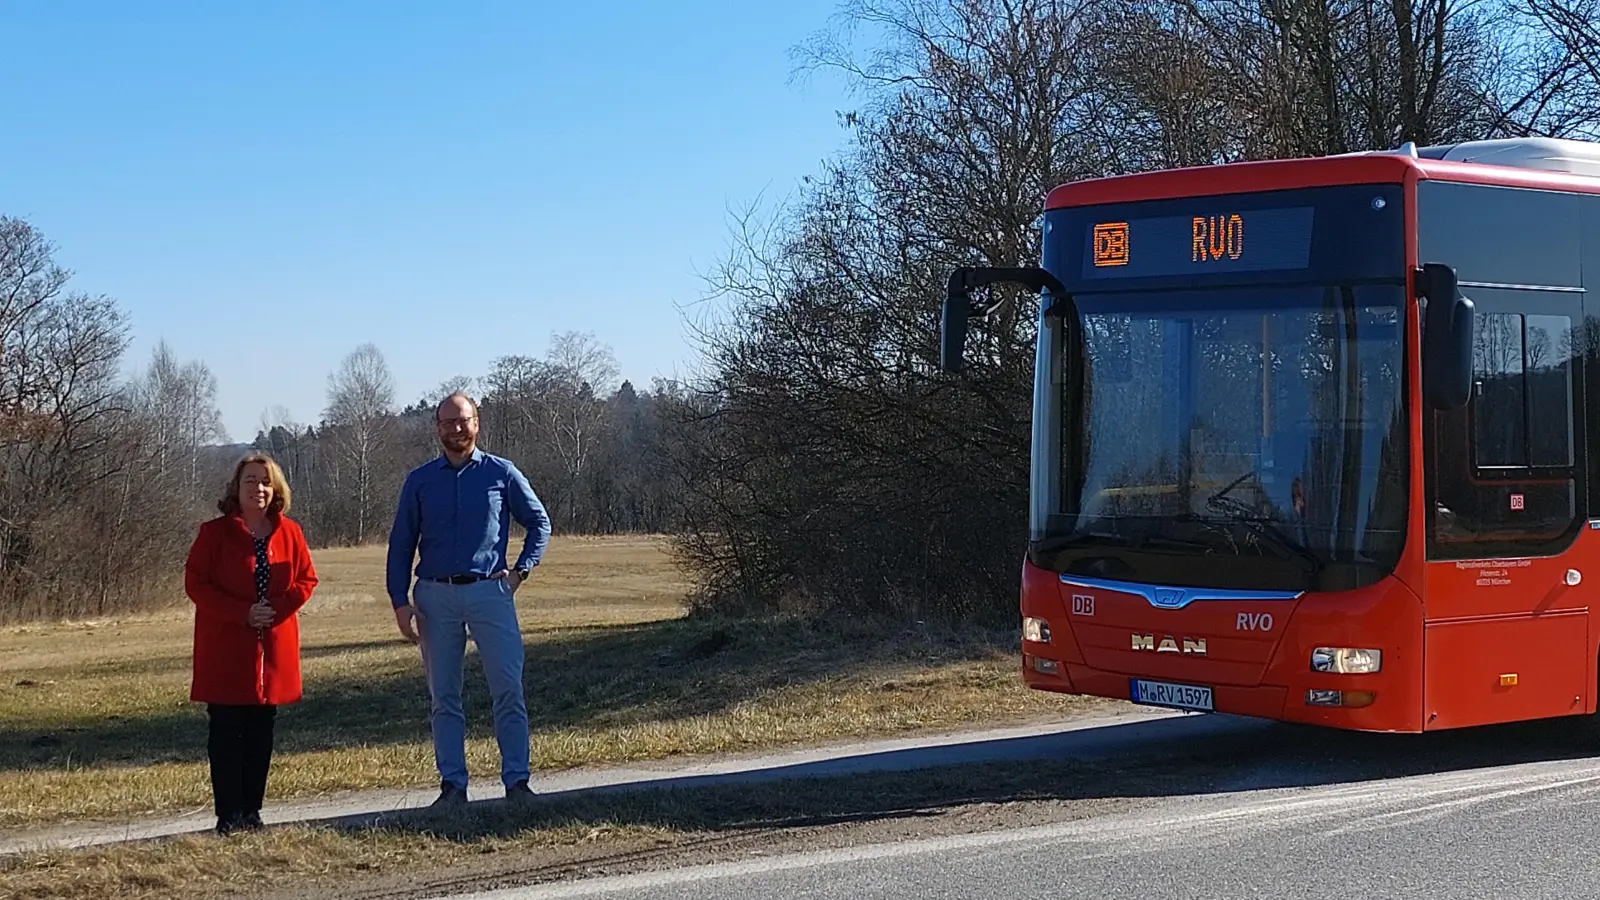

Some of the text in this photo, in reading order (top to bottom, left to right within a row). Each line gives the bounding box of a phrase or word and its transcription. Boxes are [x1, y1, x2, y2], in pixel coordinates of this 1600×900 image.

[1097, 228, 1126, 261] DB
[1512, 496, 1523, 508] DB
[1073, 596, 1094, 614] DB
[1236, 612, 1273, 631] RVO
[1131, 632, 1207, 655] MAN
[1140, 683, 1210, 707] M RV 1597
